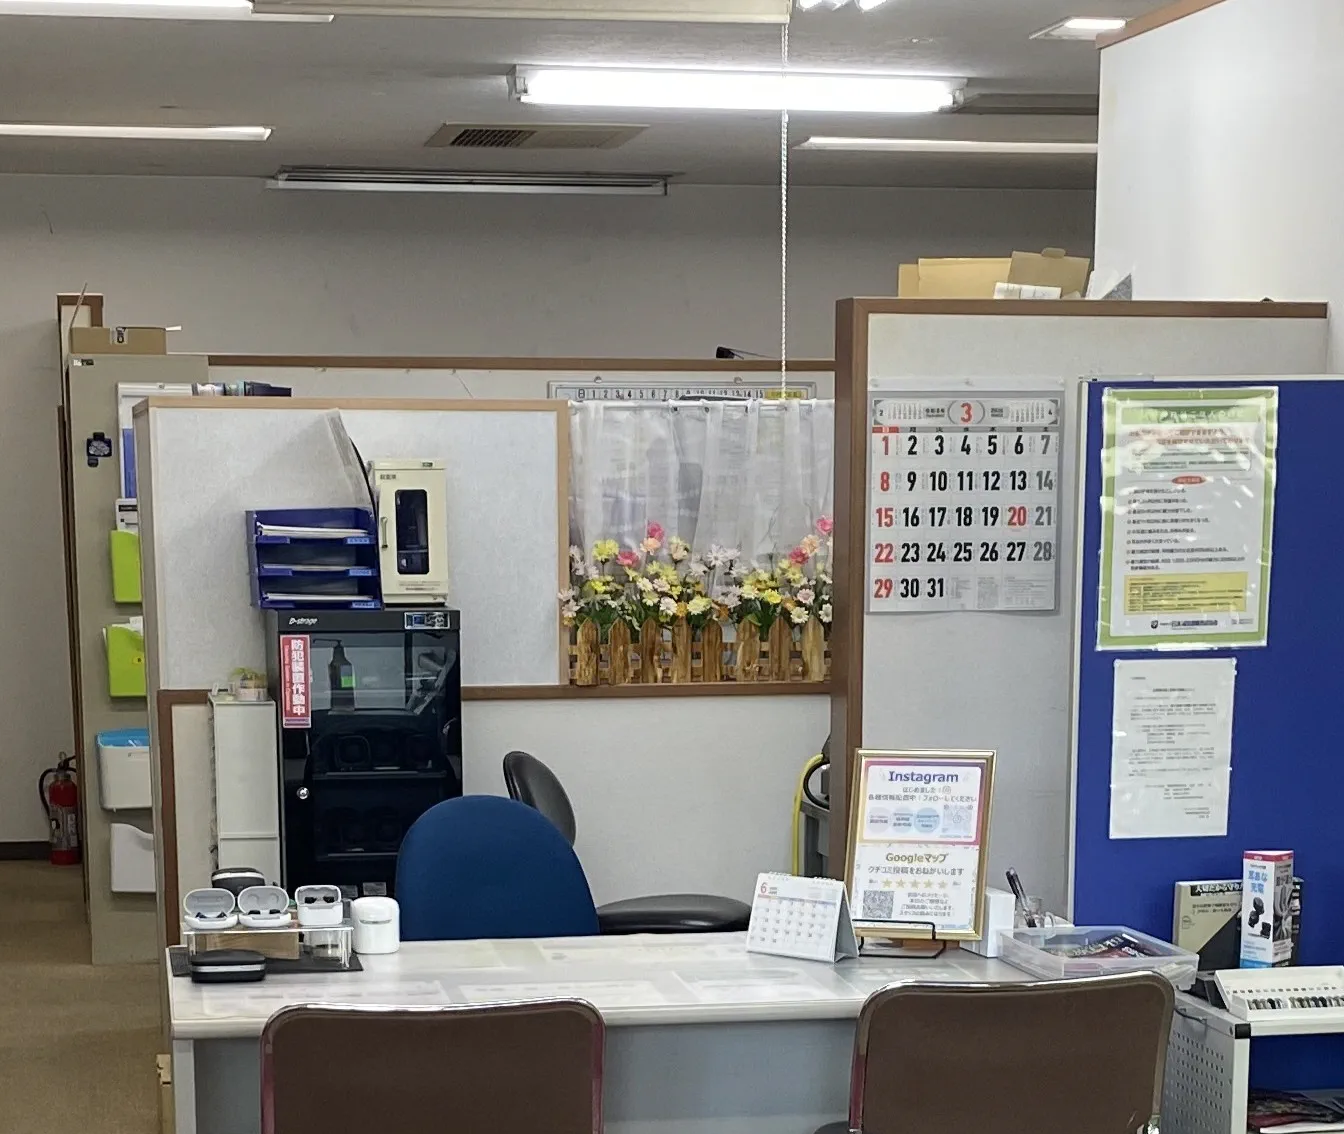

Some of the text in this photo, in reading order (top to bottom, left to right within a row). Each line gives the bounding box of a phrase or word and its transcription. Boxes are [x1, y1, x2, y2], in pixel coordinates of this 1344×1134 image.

[960, 403, 973, 423] 3
[882, 435, 1050, 455] 1 2 3 4 5 6 7
[880, 471, 1053, 491] 8 9 10 11 12 13 14
[876, 506, 1052, 527] 15 16 17 18 19 20 21
[875, 542, 1052, 563] 22 23 24 25 26 27 28
[874, 578, 893, 598] 29
[900, 578, 919, 598] 30
[927, 578, 944, 598] 31
[887, 771, 959, 784] Instagram
[886, 853, 950, 864] Googleマップ
